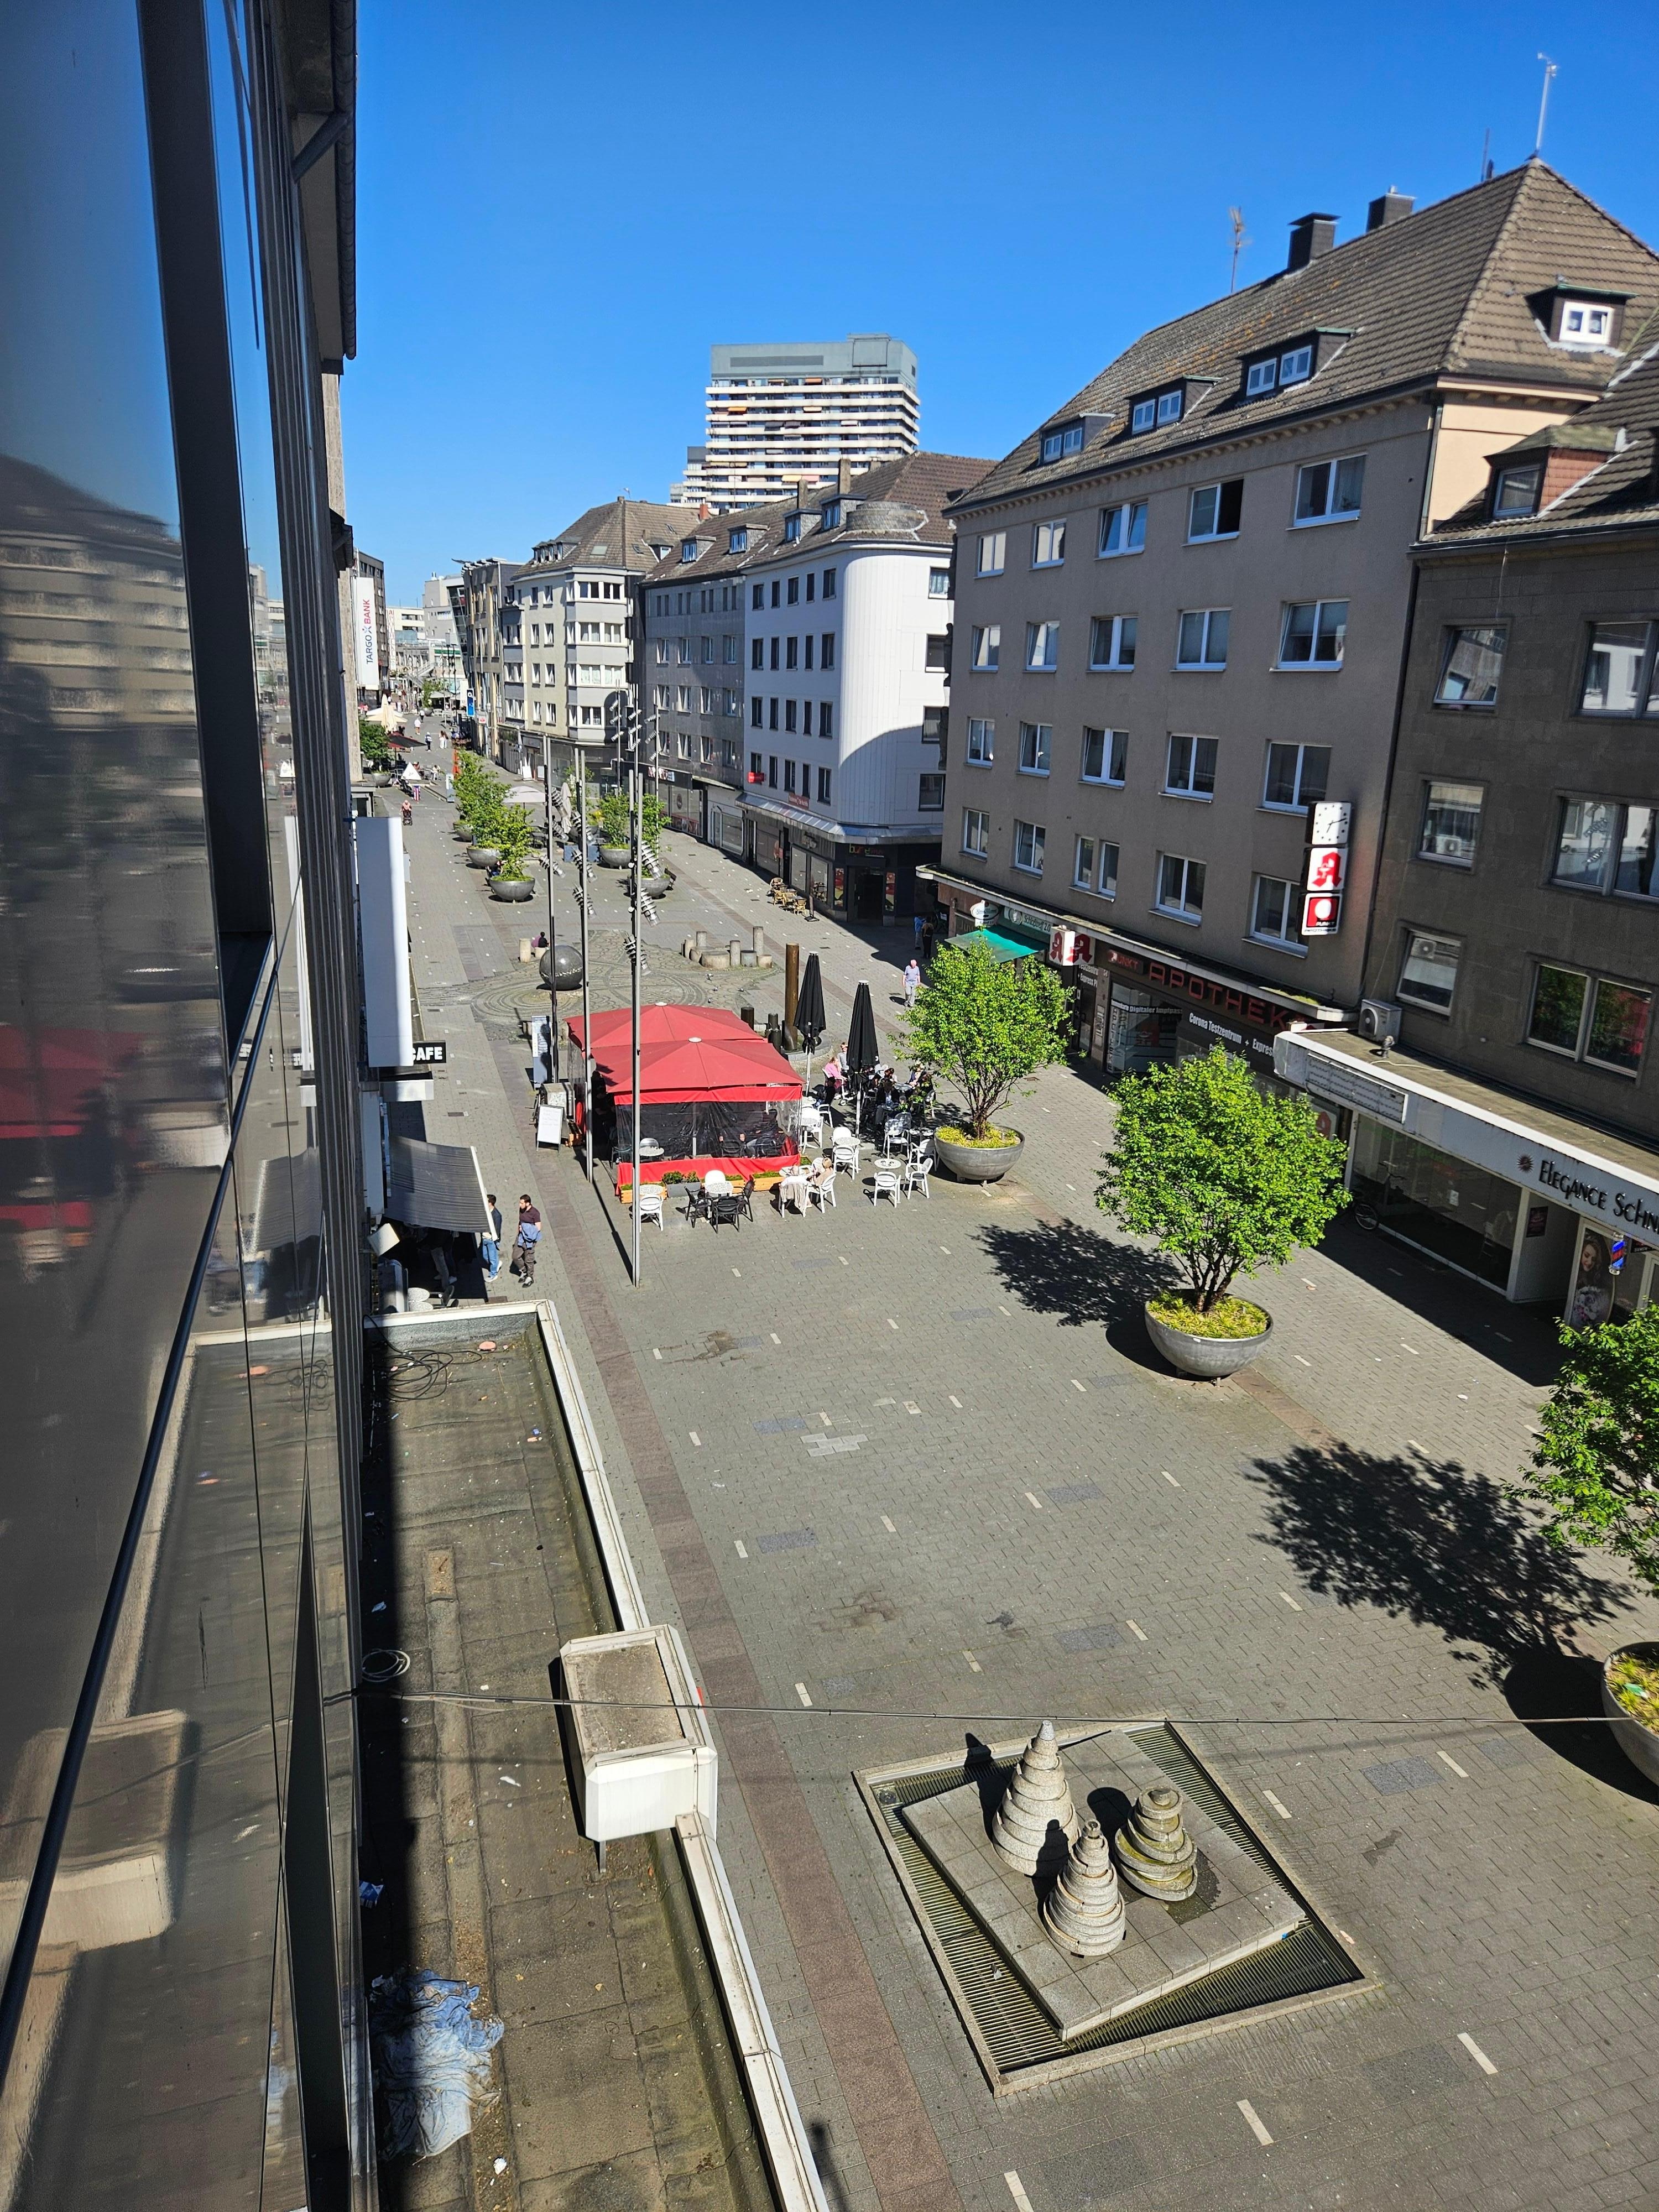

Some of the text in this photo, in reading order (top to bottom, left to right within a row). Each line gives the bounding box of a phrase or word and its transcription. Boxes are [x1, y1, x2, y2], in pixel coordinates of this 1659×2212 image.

[1189, 1012, 1208, 1030] Corona
[1208, 1020, 1243, 1045] Testzentrum
[1252, 1038, 1272, 1057] Expres
